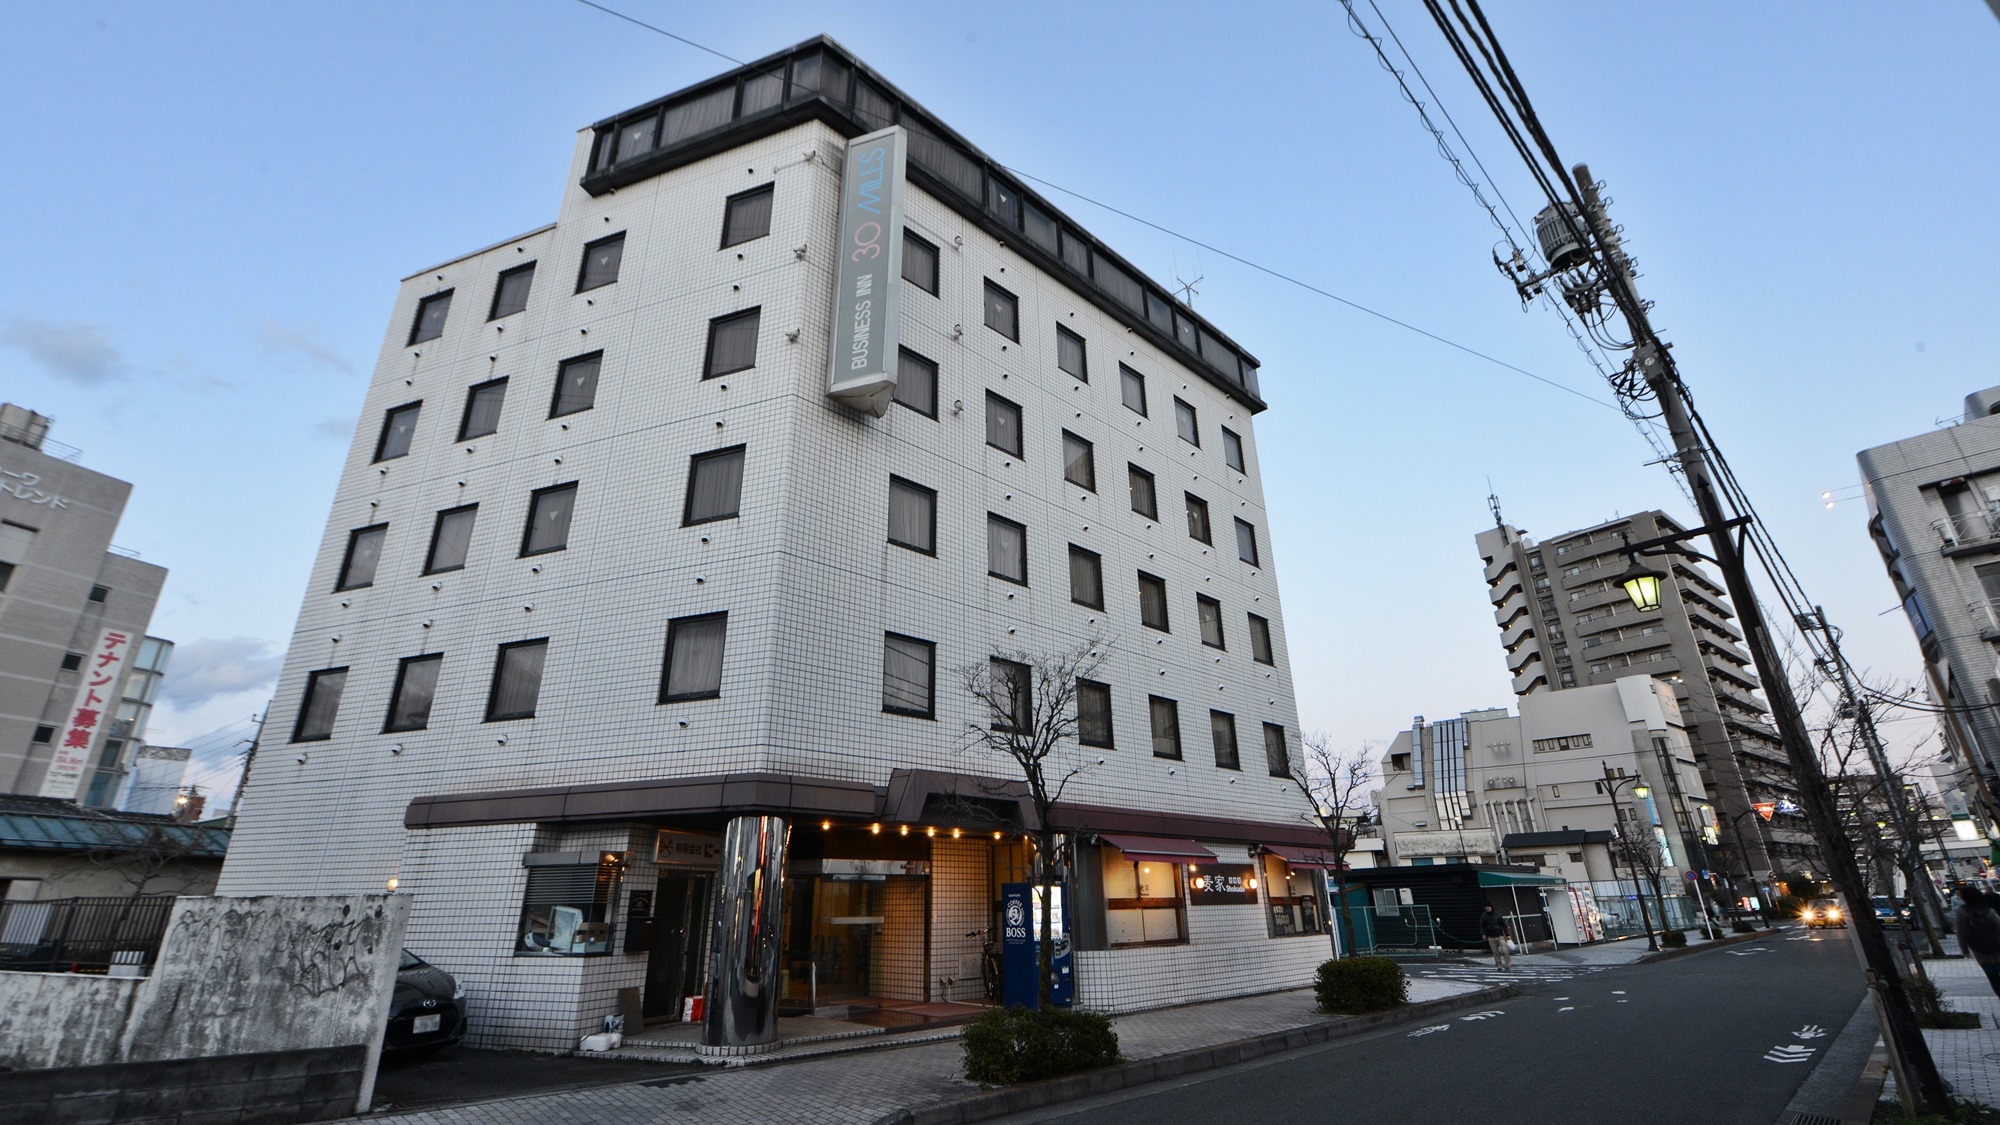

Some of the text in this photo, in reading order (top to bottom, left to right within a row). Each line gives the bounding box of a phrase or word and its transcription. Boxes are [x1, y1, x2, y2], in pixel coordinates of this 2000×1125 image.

[851, 147, 886, 370] BUSINESS INN 30 MILES
[64, 632, 127, 750] テナント募集
[1005, 927, 1026, 938] BOSS
[1007, 899, 1023, 908] COFFEE
